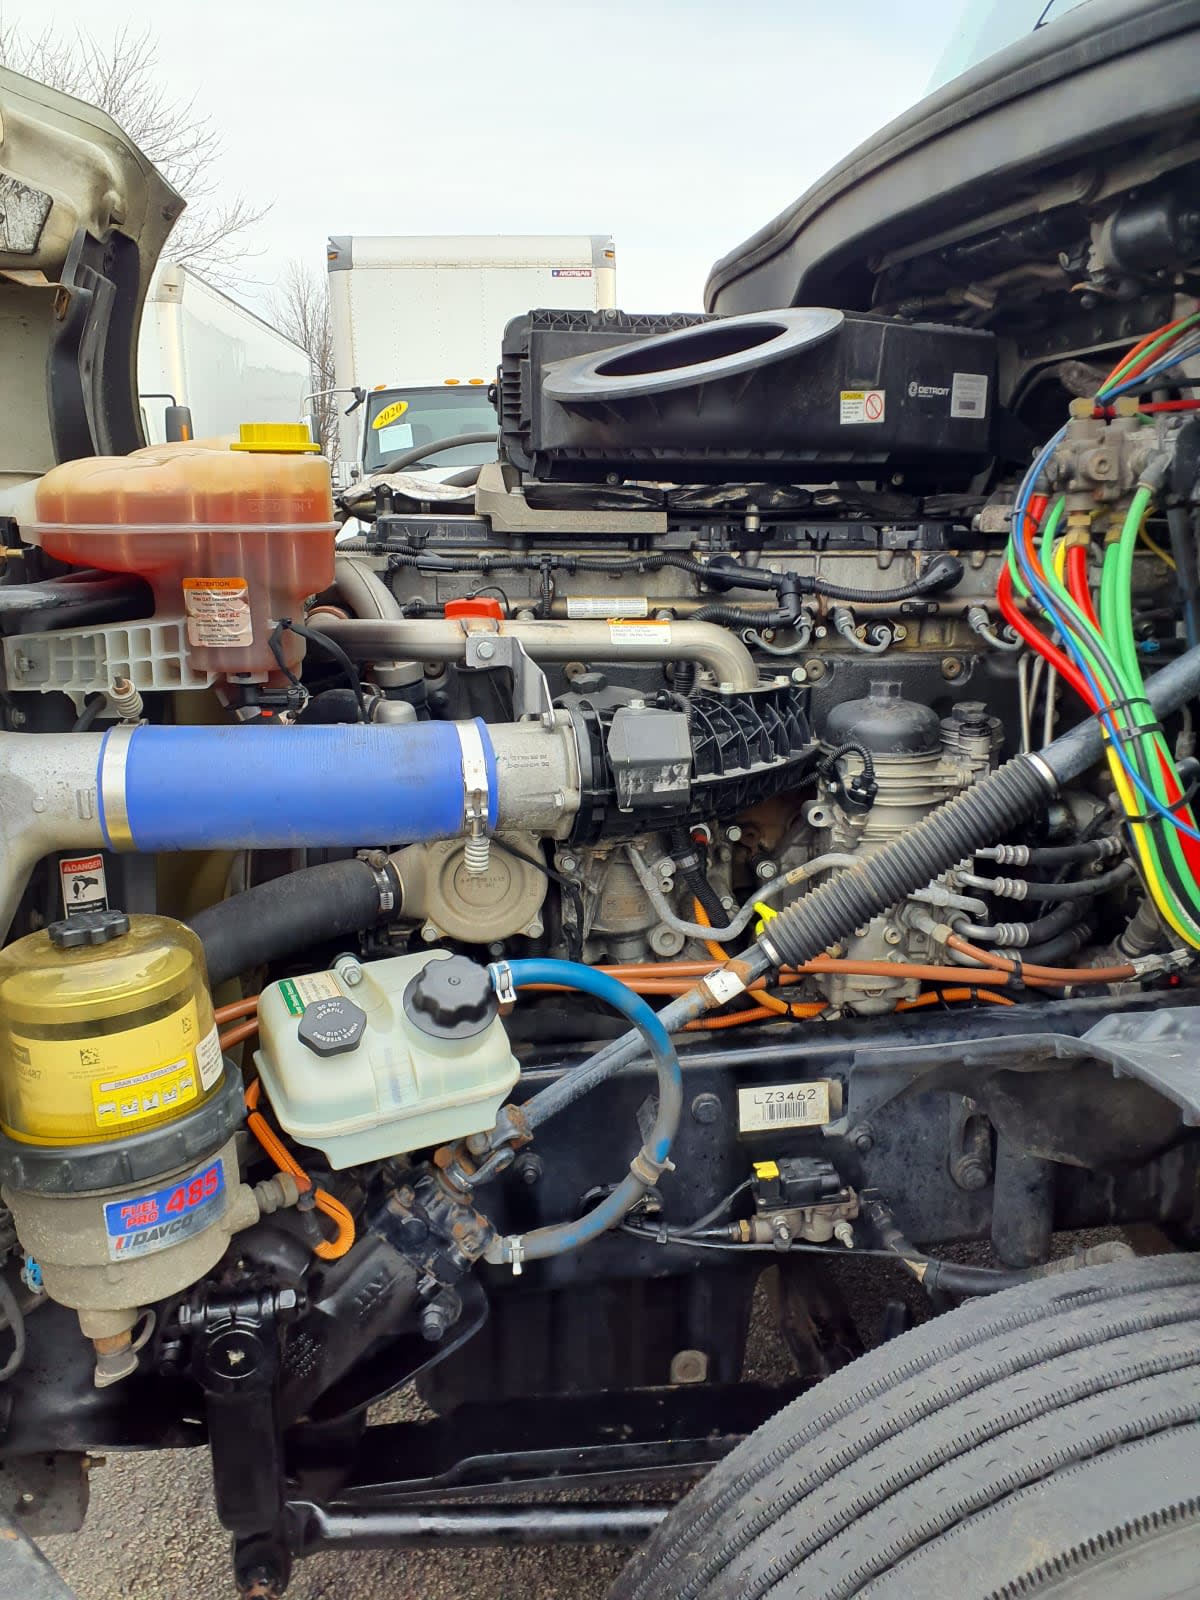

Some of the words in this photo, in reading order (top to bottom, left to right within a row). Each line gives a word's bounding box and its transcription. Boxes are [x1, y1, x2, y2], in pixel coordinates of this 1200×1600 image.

[918, 386, 950, 396] DETROIT
[379, 402, 402, 426] 2020
[71, 860, 102, 870] DANGER
[316, 1008, 345, 1019] OVERFILL
[312, 1031, 342, 1042] STEERING
[326, 1028, 347, 1036] FLUID
[343, 1022, 359, 1039] POWER
[115, 1080, 131, 1088] DRAIN
[151, 1065, 178, 1078] OPERATION
[754, 1089, 816, 1104] LZ3462
[121, 1199, 159, 1218] FUEL
[166, 1167, 218, 1212] 485
[126, 1211, 159, 1229] PRO
[132, 1214, 193, 1246] DAVCO
